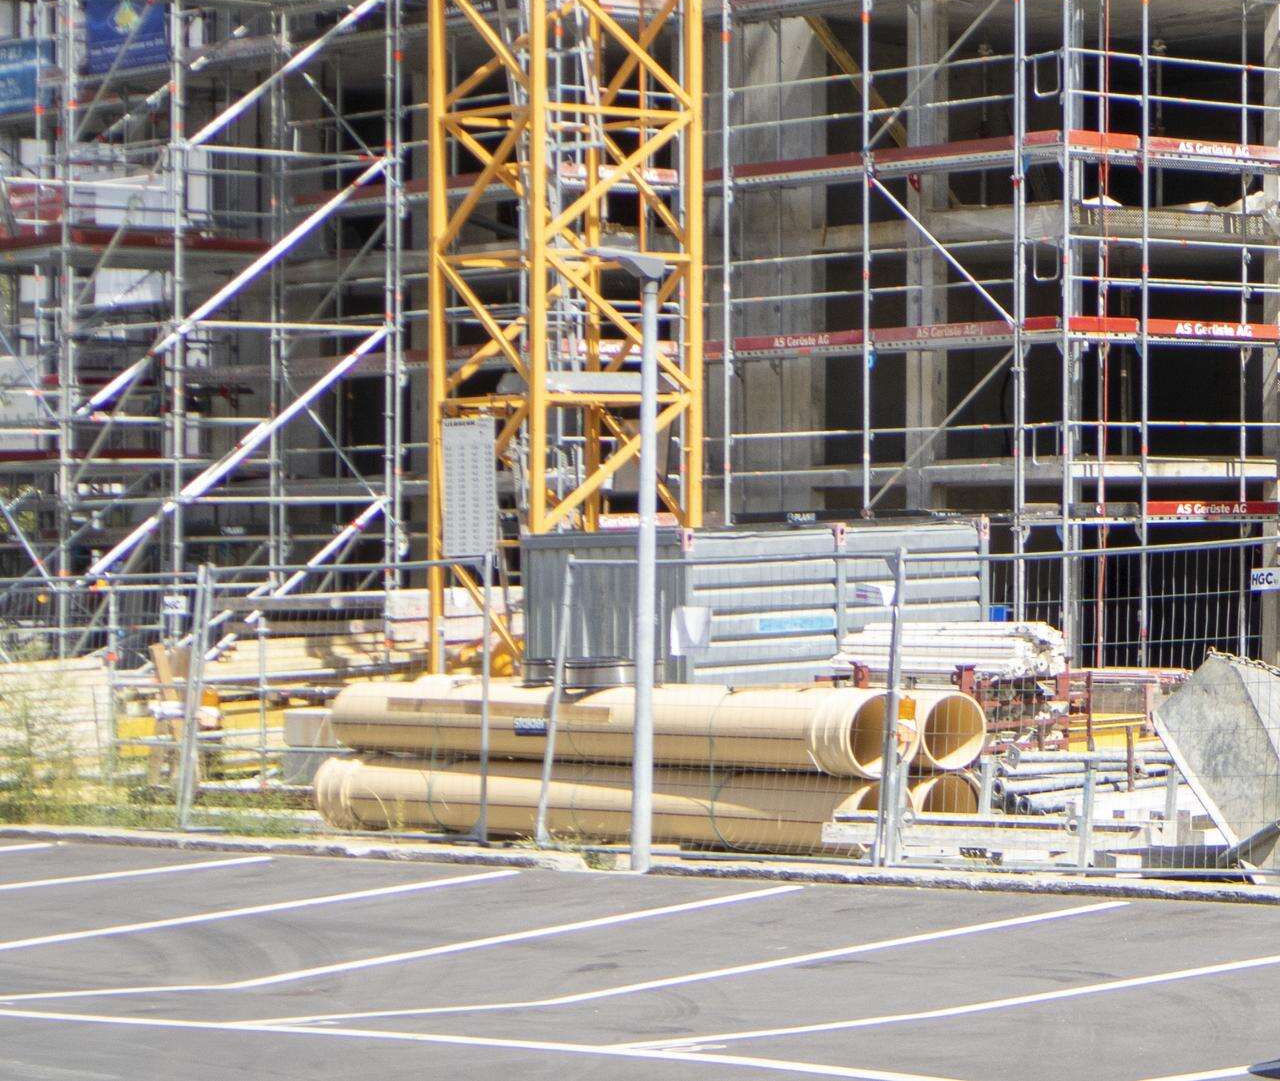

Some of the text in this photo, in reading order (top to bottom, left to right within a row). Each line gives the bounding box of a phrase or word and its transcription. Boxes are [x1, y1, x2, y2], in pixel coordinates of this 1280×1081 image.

[1178, 142, 1194, 153] AS
[1235, 145, 1250, 157] AG
[1175, 322, 1192, 335] AS
[1236, 324, 1253, 337] AG
[774, 336, 785, 348] AS
[818, 334, 830, 345] AG
[1176, 503, 1247, 514] AS Gerüste AG
[1252, 572, 1273, 585] HGC
